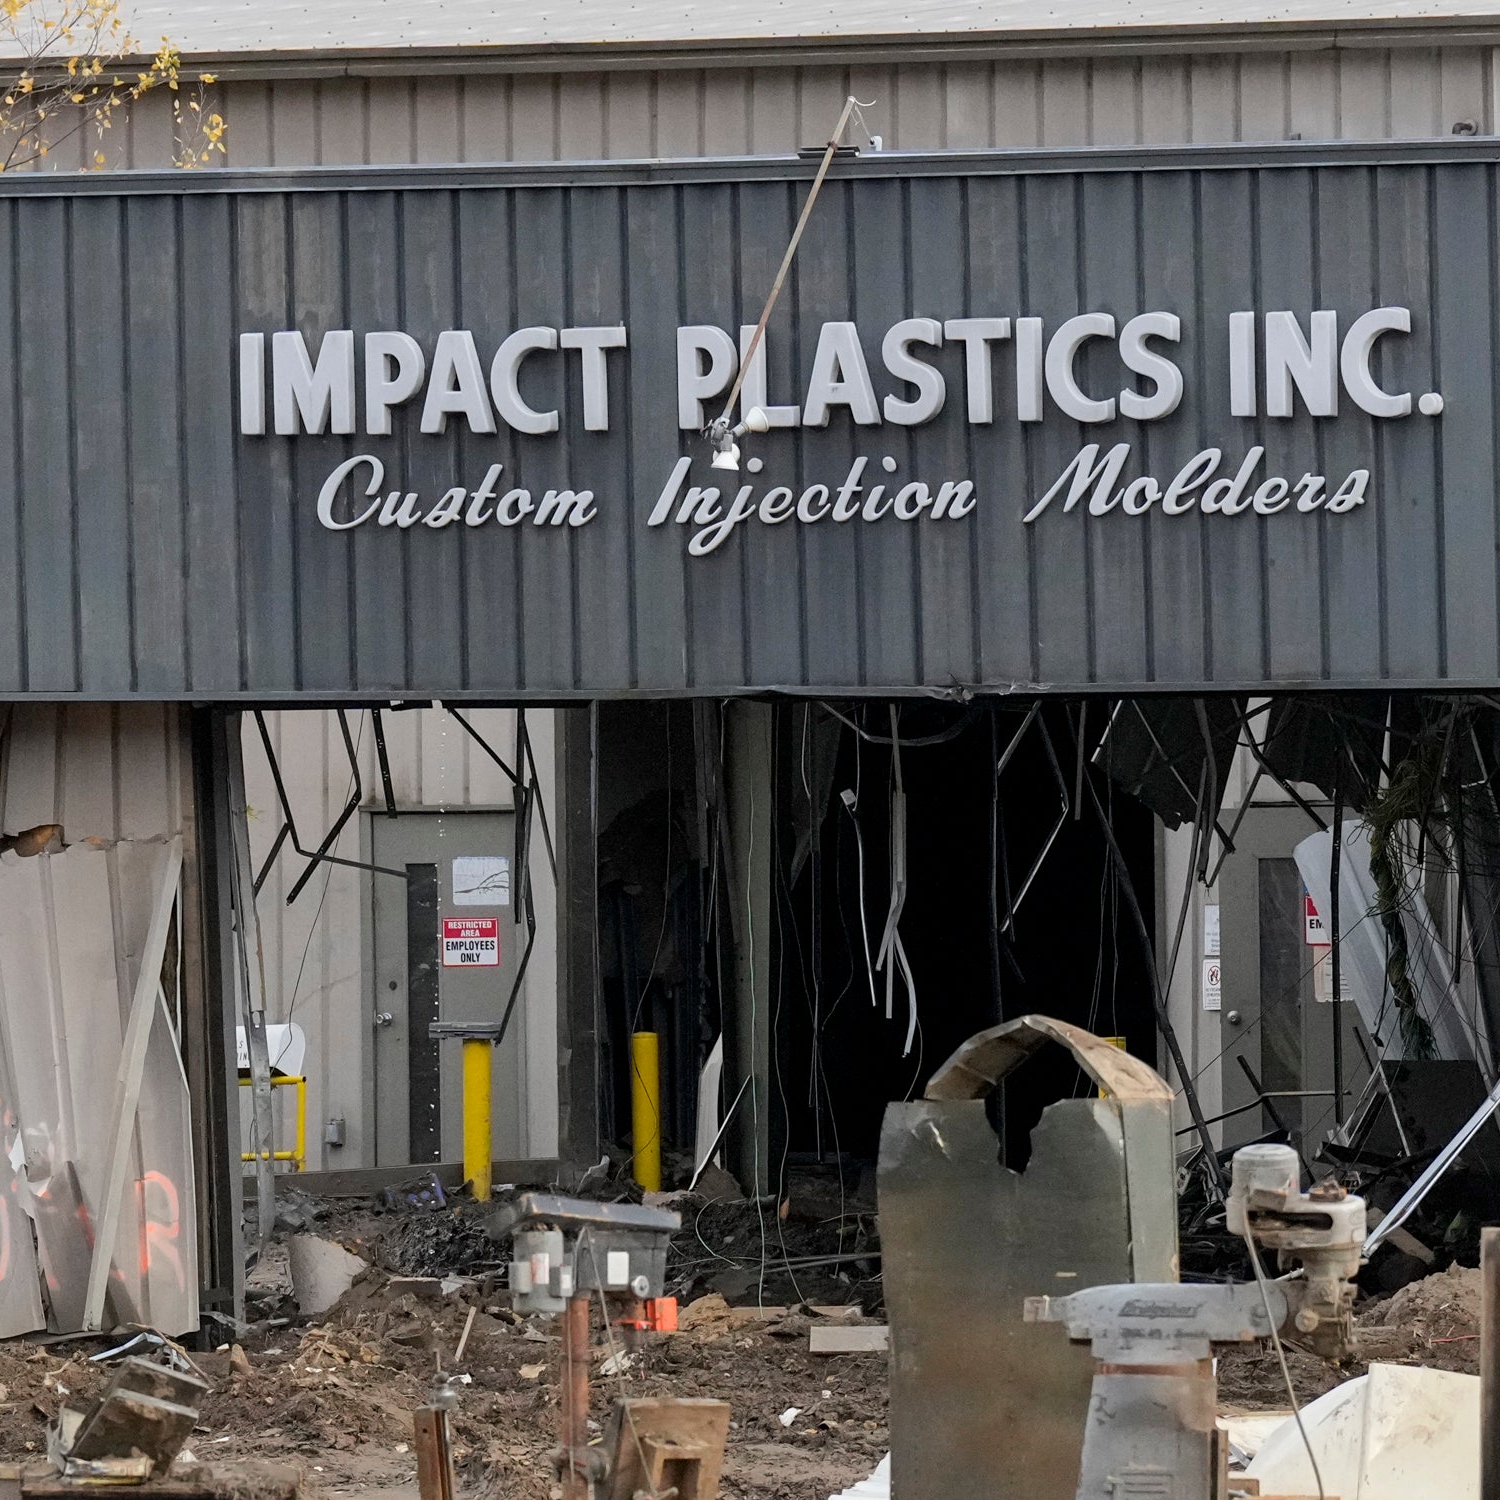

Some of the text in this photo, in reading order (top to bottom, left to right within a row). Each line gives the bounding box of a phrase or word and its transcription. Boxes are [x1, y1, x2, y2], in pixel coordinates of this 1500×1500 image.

[239, 306, 1445, 436] IMPACT PLASTICS INC.
[316, 442, 1370, 557] Custom Injection Molders
[448, 921, 492, 929] RESTRICTED
[445, 940, 495, 951] EMPLOYEES
[460, 953, 481, 963] ONLY
